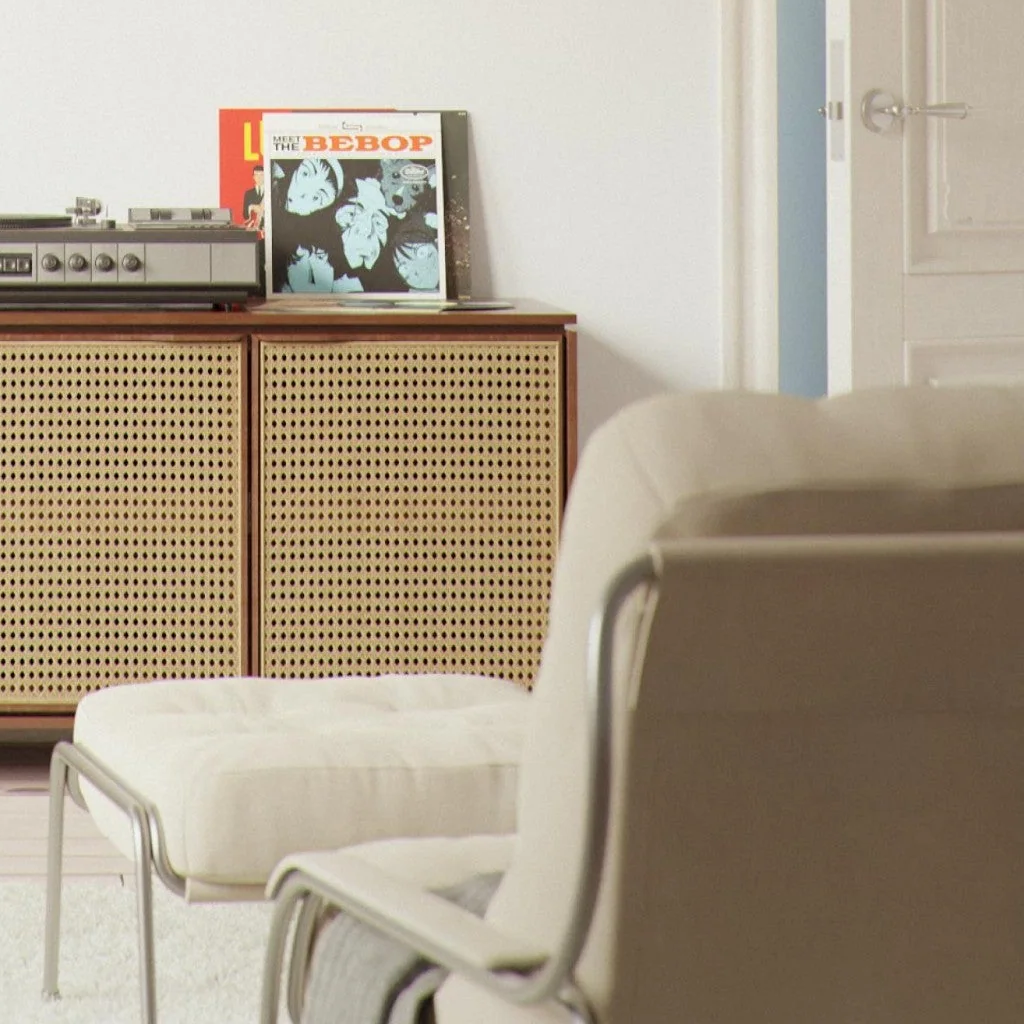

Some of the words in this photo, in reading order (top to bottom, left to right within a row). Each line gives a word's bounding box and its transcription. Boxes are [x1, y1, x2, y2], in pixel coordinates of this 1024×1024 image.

[244, 121, 263, 161] L
[273, 143, 299, 151] THE
[303, 135, 432, 152] BEBOP
